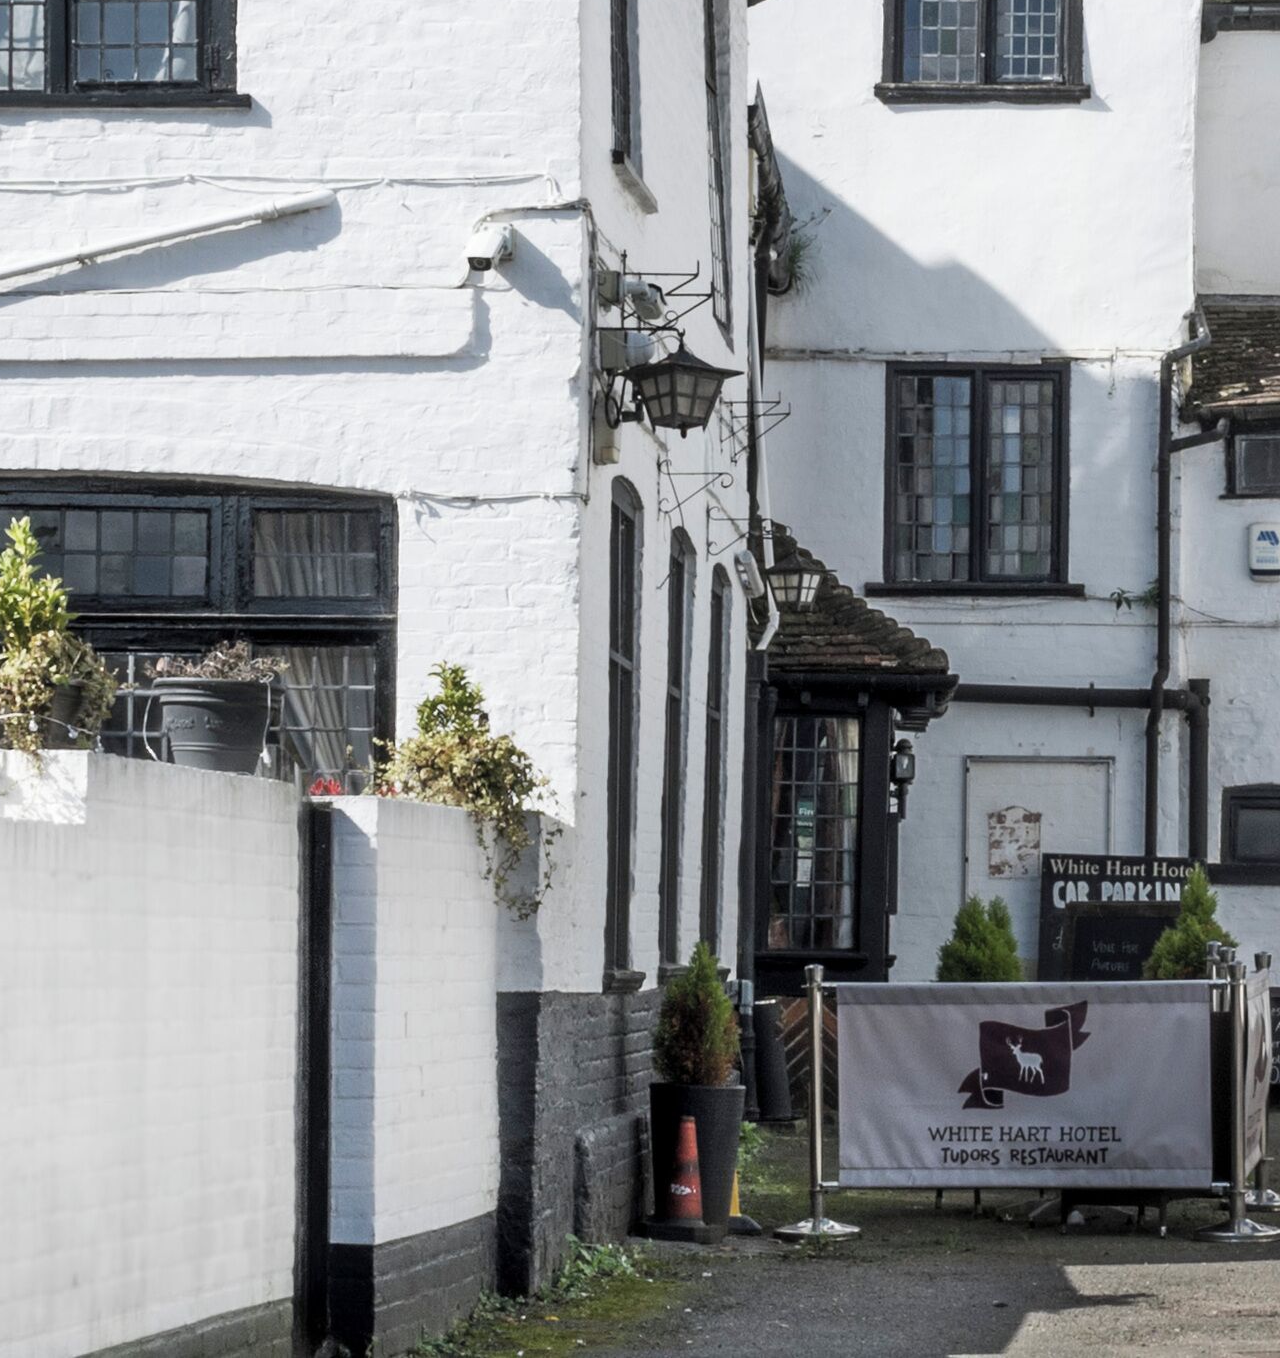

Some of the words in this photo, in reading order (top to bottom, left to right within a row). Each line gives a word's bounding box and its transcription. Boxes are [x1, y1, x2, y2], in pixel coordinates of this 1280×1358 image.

[1050, 858, 1100, 876] White
[1106, 860, 1146, 877] Hart
[1053, 880, 1090, 909] CAR
[1101, 881, 1188, 902] PARKIN
[928, 1126, 993, 1142] WHITE
[999, 1126, 1051, 1142] HART
[1060, 1126, 1121, 1143] HOTEL
[941, 1147, 1000, 1165] TUDORS
[1010, 1147, 1109, 1165] RESTAURANT
